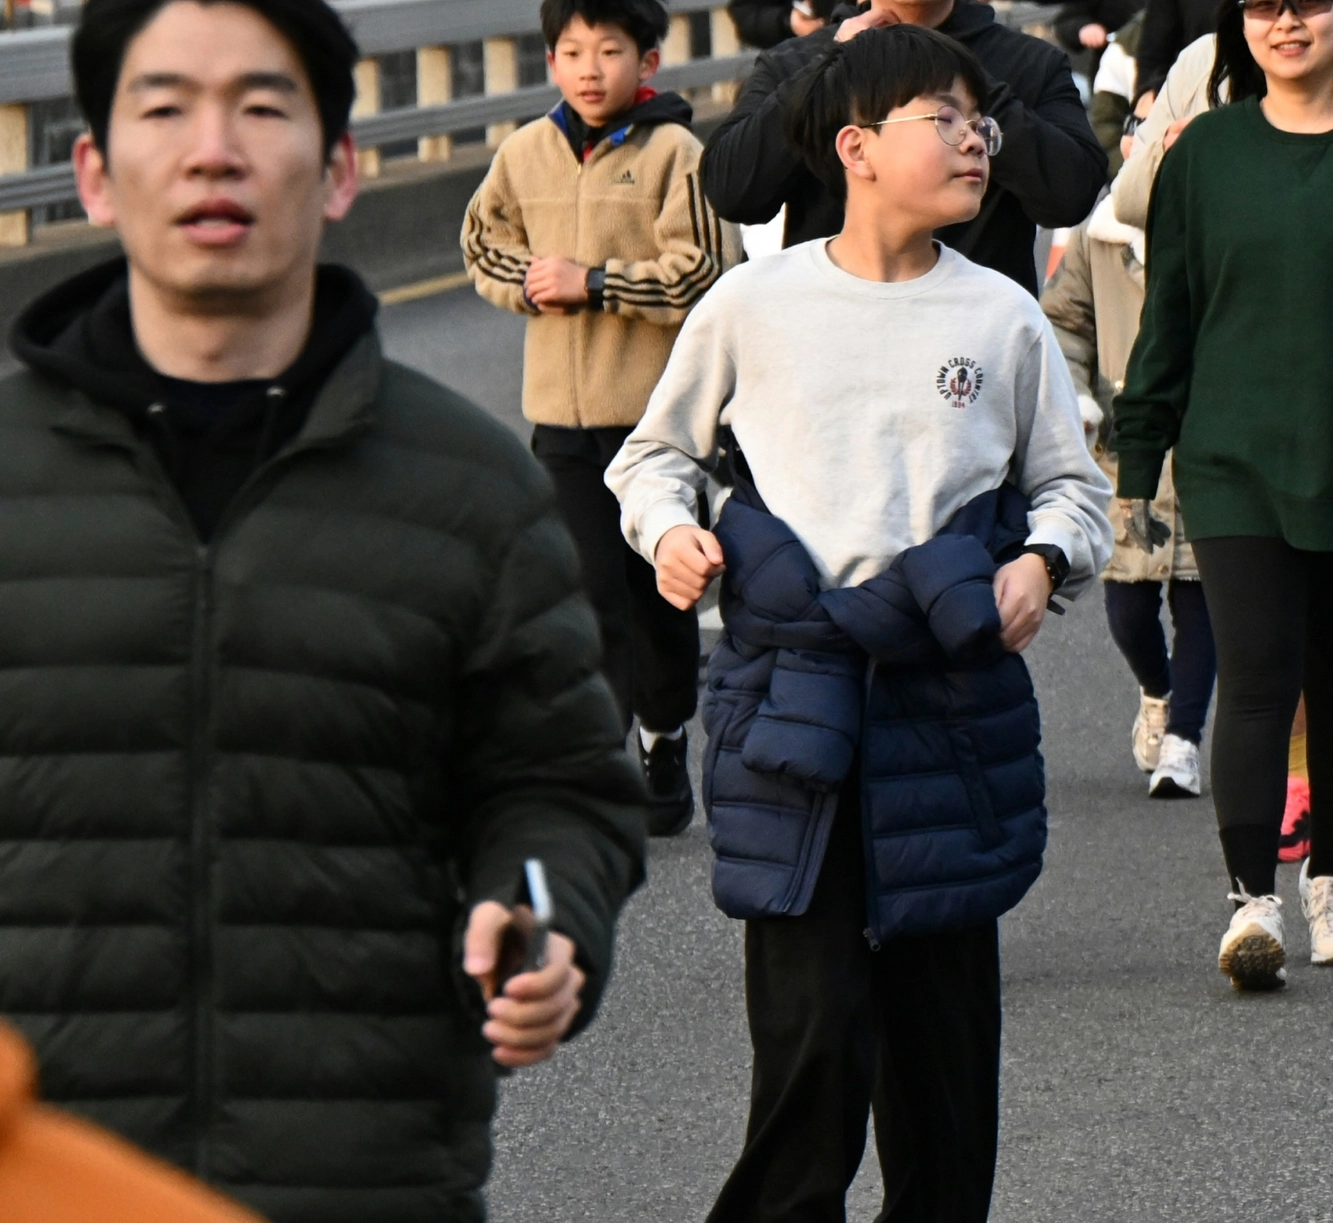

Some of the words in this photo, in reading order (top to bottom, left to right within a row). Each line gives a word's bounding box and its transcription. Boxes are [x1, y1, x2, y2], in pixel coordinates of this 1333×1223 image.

[936, 366, 951, 400] UPTOWN
[948, 357, 976, 369] CROSS
[968, 367, 984, 404] COUNTRY
